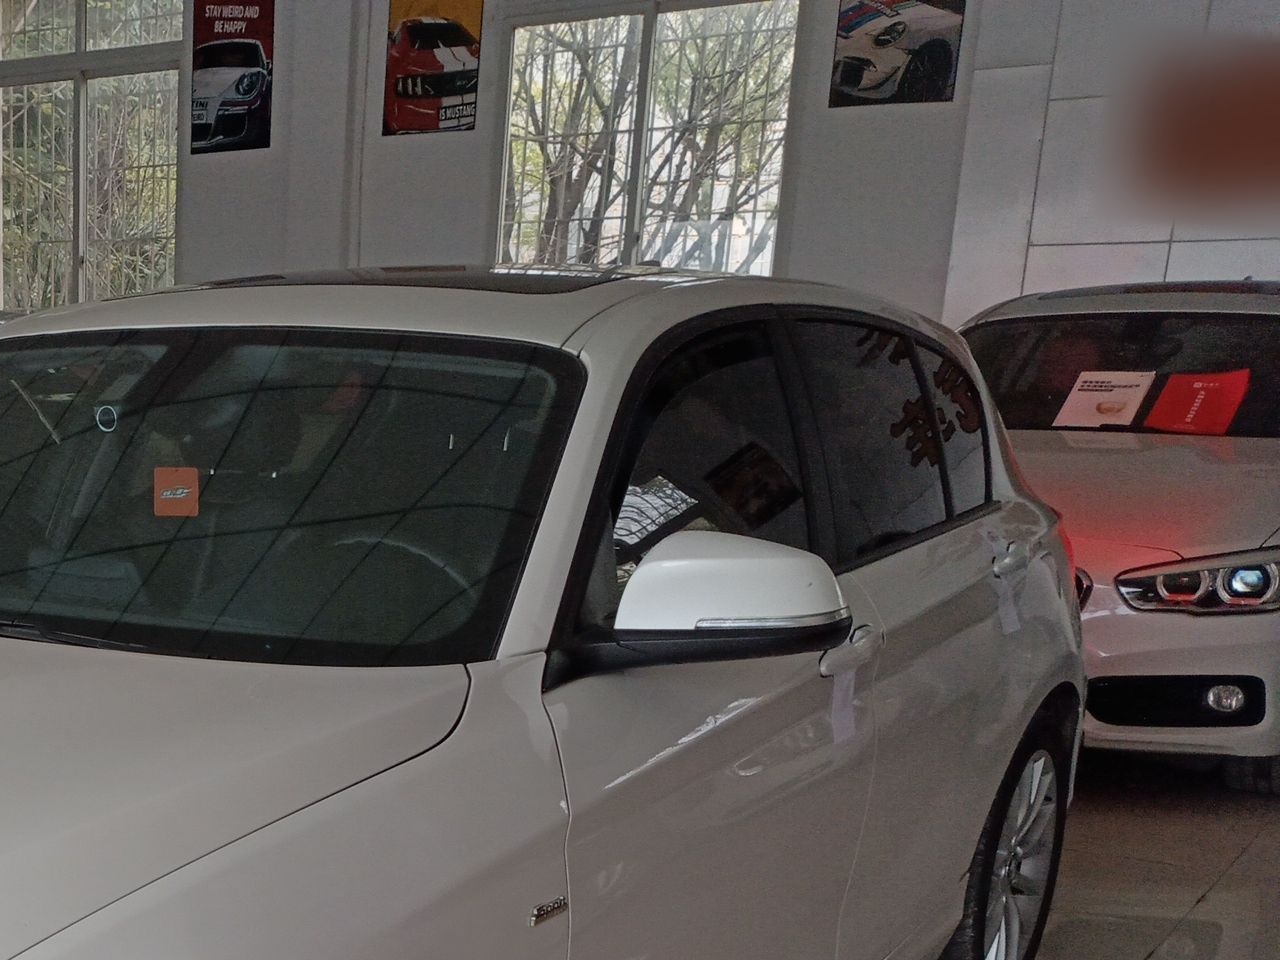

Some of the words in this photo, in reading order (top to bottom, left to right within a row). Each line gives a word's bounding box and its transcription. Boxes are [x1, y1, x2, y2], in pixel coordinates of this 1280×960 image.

[205, 5, 221, 18] STAY
[222, 5, 244, 18] WEIRD
[244, 5, 260, 18] AND
[214, 20, 223, 33] BE
[223, 20, 247, 34] HAPPY
[447, 104, 475, 119] MUSTANG
